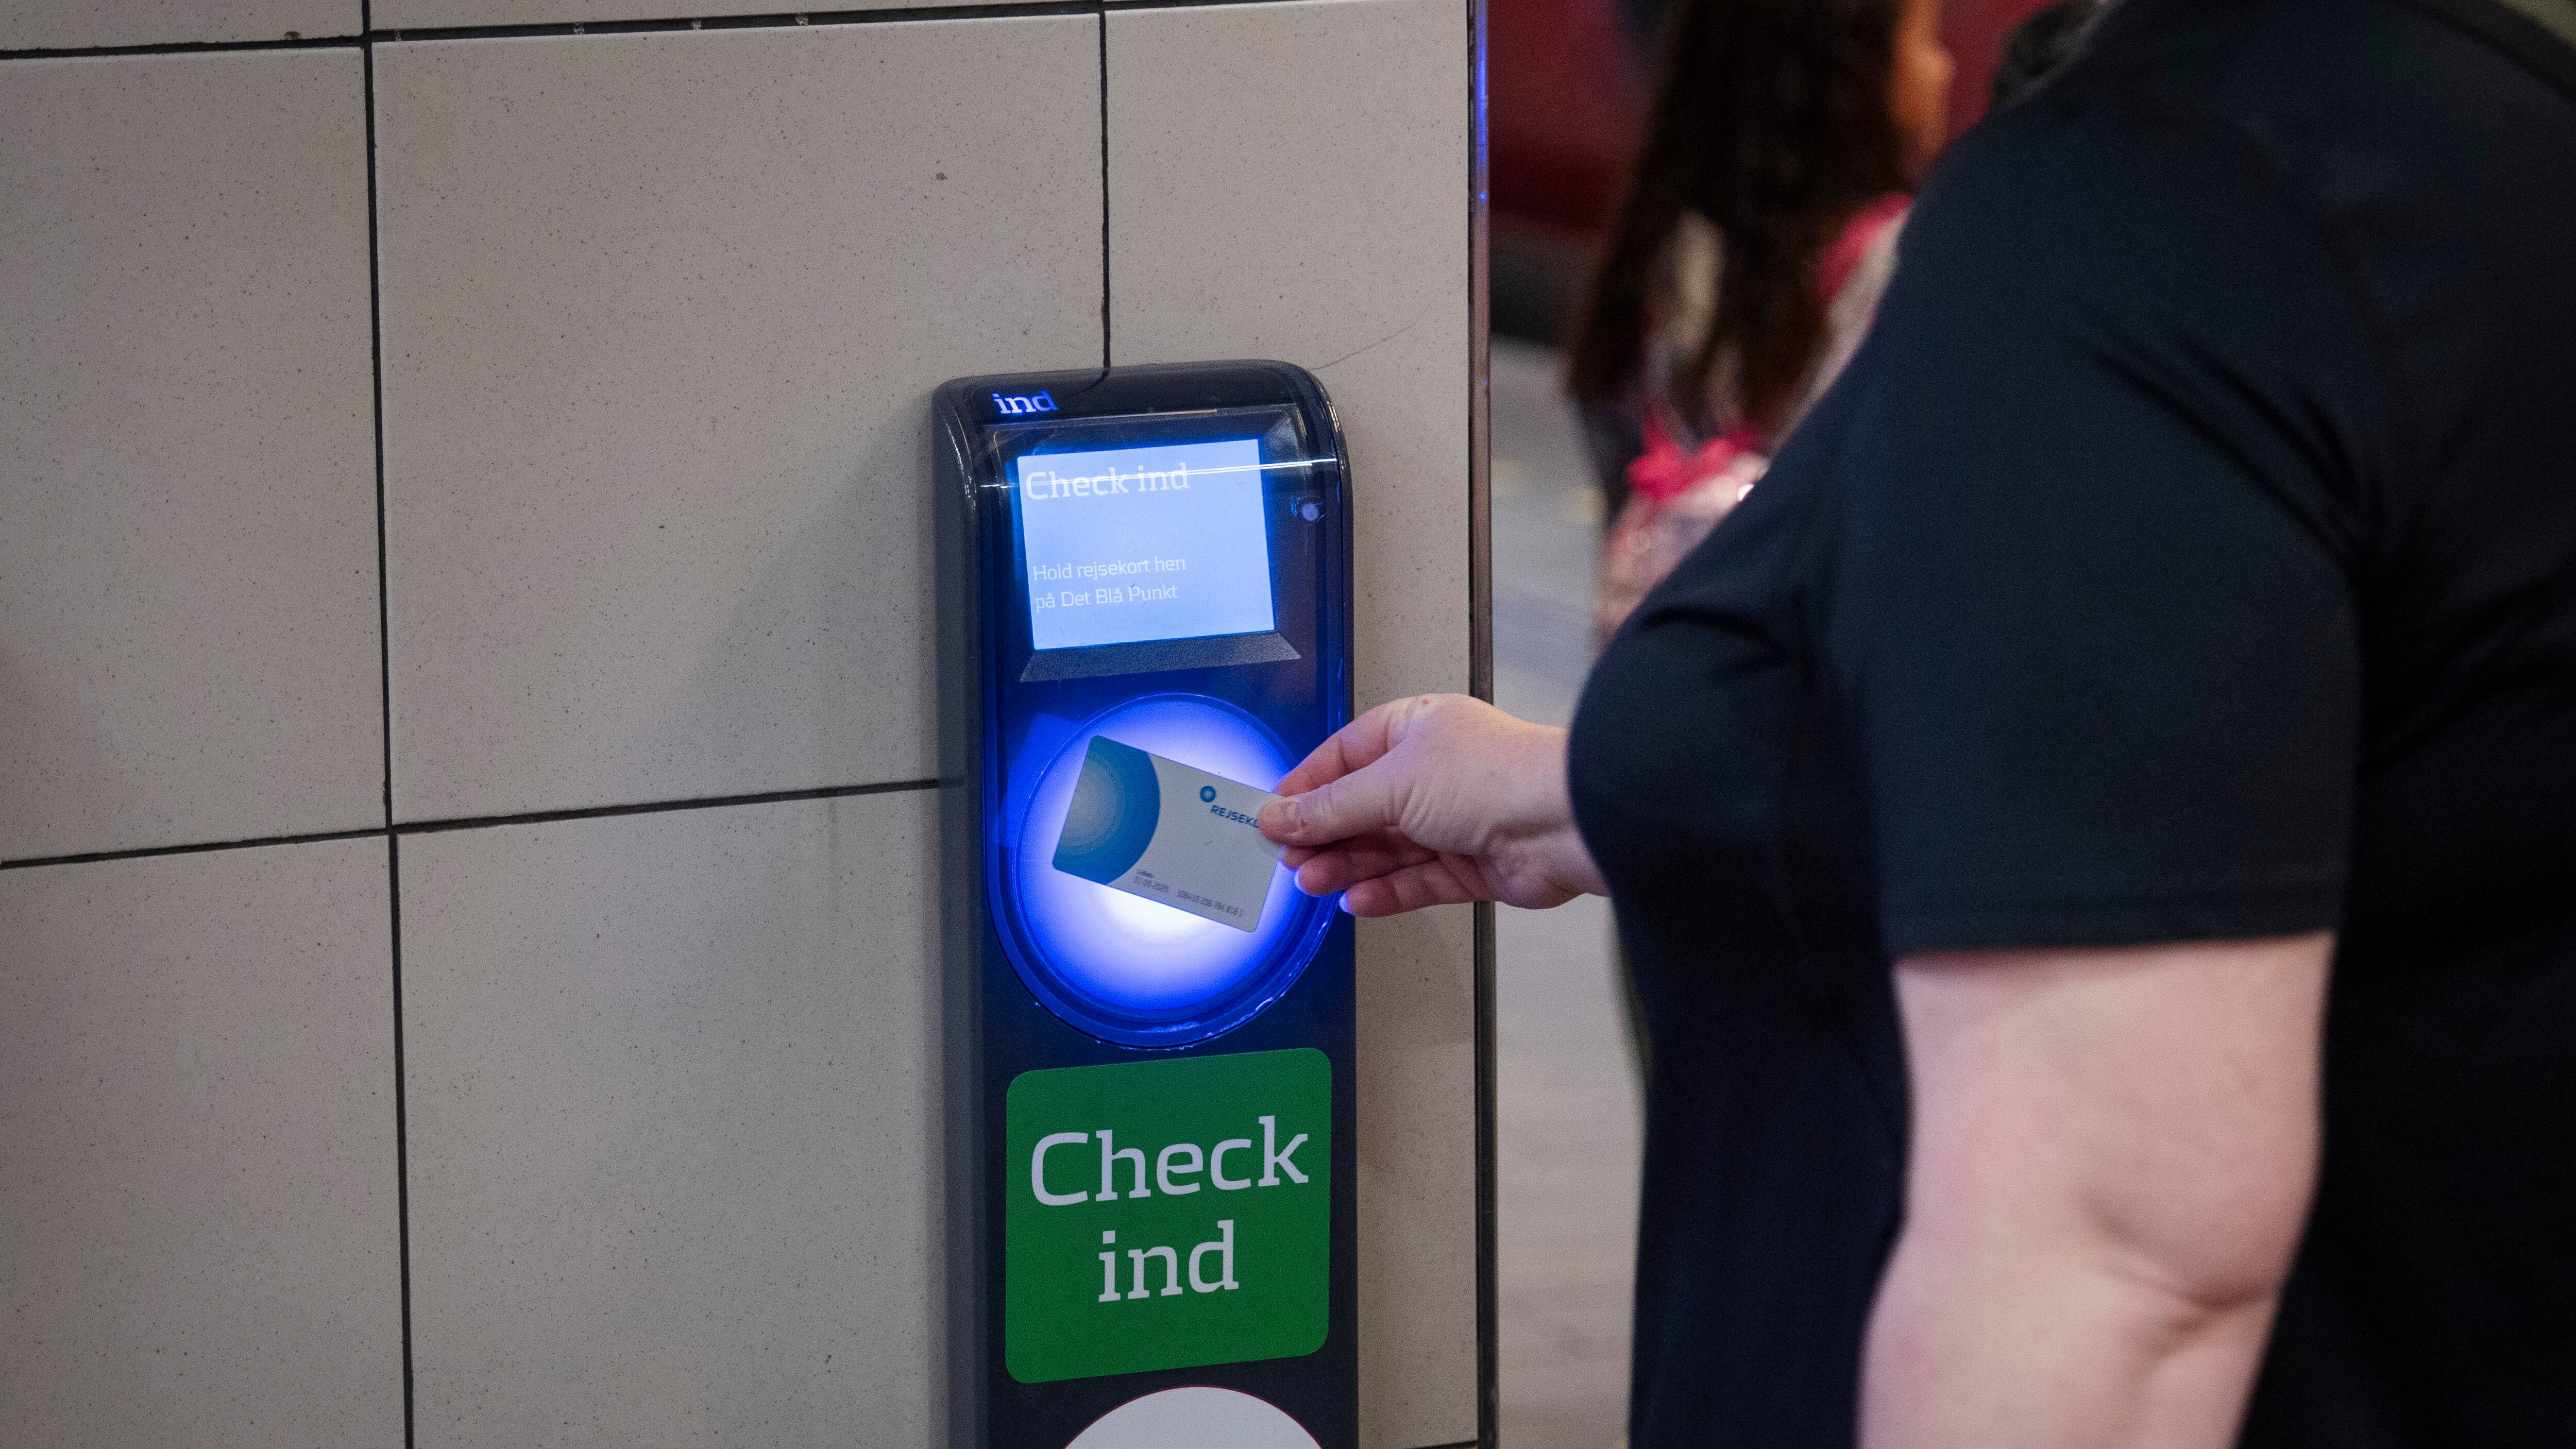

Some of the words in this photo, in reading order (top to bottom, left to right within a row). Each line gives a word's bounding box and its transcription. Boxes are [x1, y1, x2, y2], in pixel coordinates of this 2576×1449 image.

[992, 390, 1059, 414] ind
[1026, 467, 1129, 500] Check
[1138, 462, 1190, 492] ind
[1033, 564, 1073, 581] Hold
[1077, 559, 1150, 580] rejsekort
[1155, 557, 1187, 572] hen
[1035, 592, 1056, 613] på
[1061, 591, 1091, 607] Det
[1095, 587, 1124, 604] Blå
[1128, 585, 1178, 602] Punkt
[1031, 1115, 1309, 1206] Check
[1098, 1219, 1239, 1302] ind
